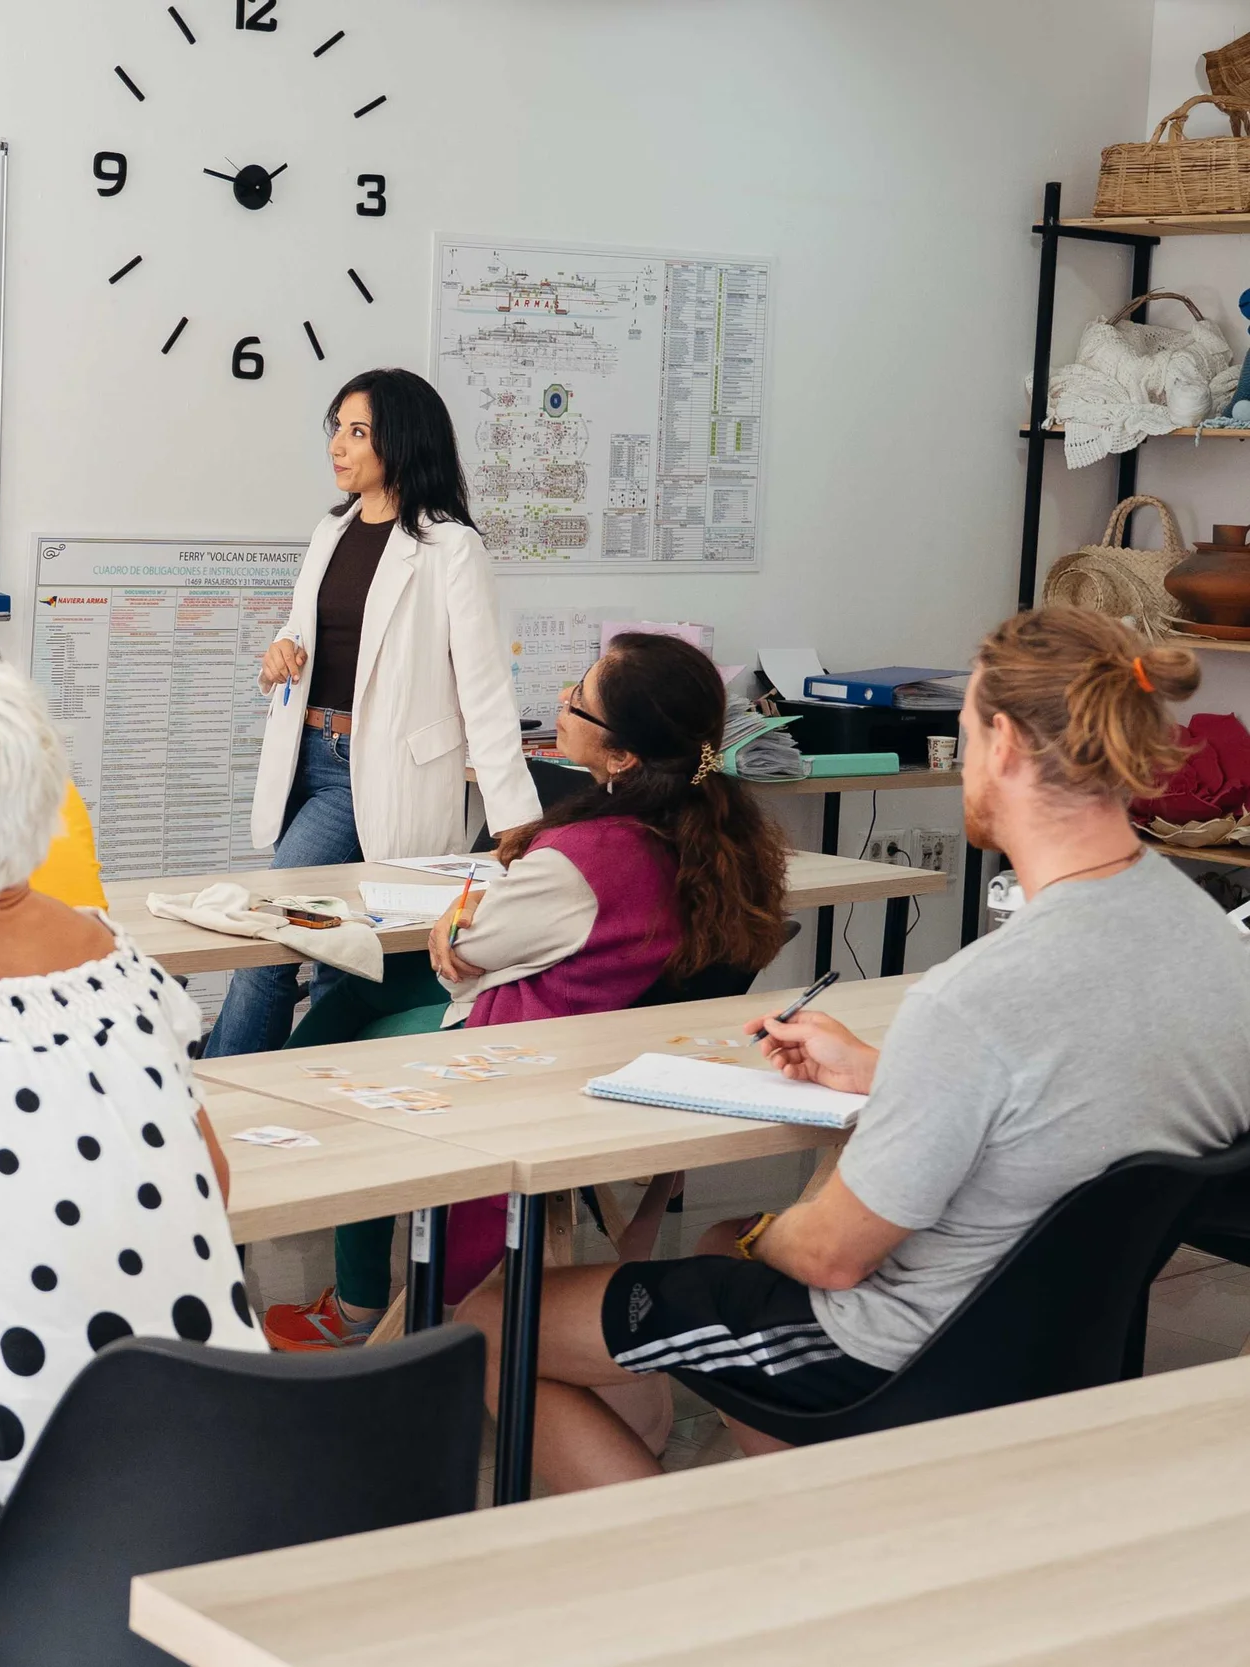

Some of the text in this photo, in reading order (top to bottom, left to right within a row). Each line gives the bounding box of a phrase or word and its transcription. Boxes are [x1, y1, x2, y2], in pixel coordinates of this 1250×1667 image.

[235, 0, 277, 32] 12
[93, 151, 127, 197] 9
[356, 174, 386, 217] 3
[513, 299, 559, 309] ARMAS
[232, 336, 264, 380] 6
[93, 566, 128, 575] CUADRO
[130, 566, 141, 575] DE
[142, 566, 201, 576] OBLIGACIONES
[210, 567, 270, 577] INSTRUCCIONES
[271, 568, 291, 577] PARA
[179, 552, 302, 562] FERRY "VOLCAN DE TAMASITE"
[204, 578, 238, 586] PASAJEROS
[629, 1283, 642, 1332] adidas
